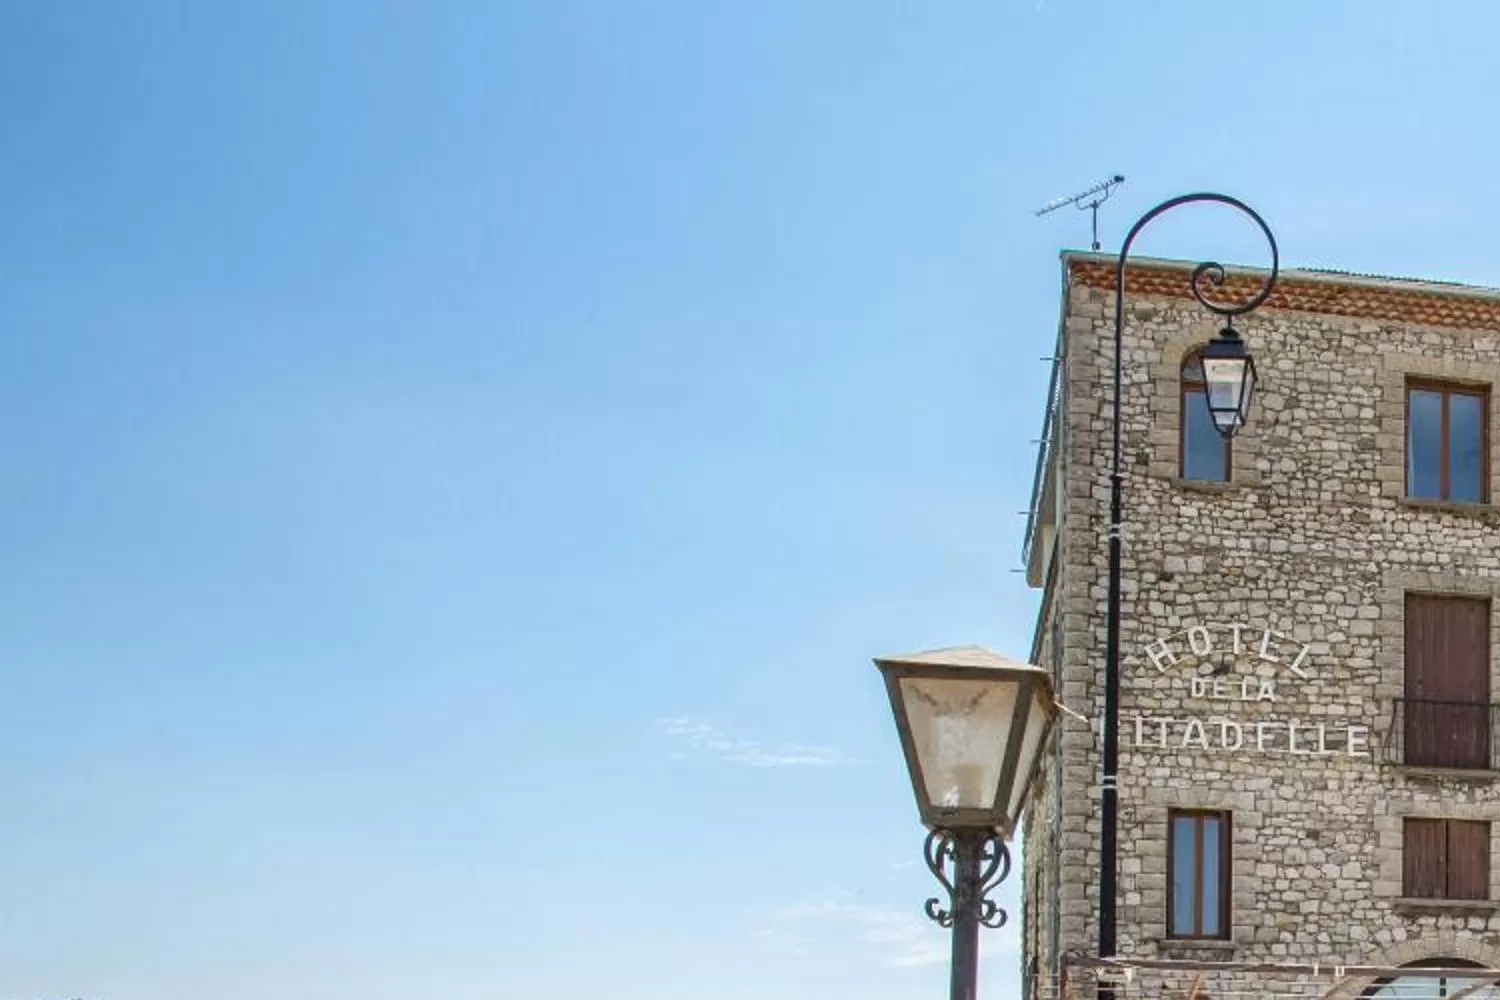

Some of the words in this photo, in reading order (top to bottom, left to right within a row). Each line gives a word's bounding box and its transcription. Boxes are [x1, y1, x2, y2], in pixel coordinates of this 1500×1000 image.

[1146, 623, 1310, 679] HOTEL
[1191, 677, 1230, 698] DE
[1240, 676, 1276, 702] LA
[1101, 713, 1370, 757] ITADELLE
